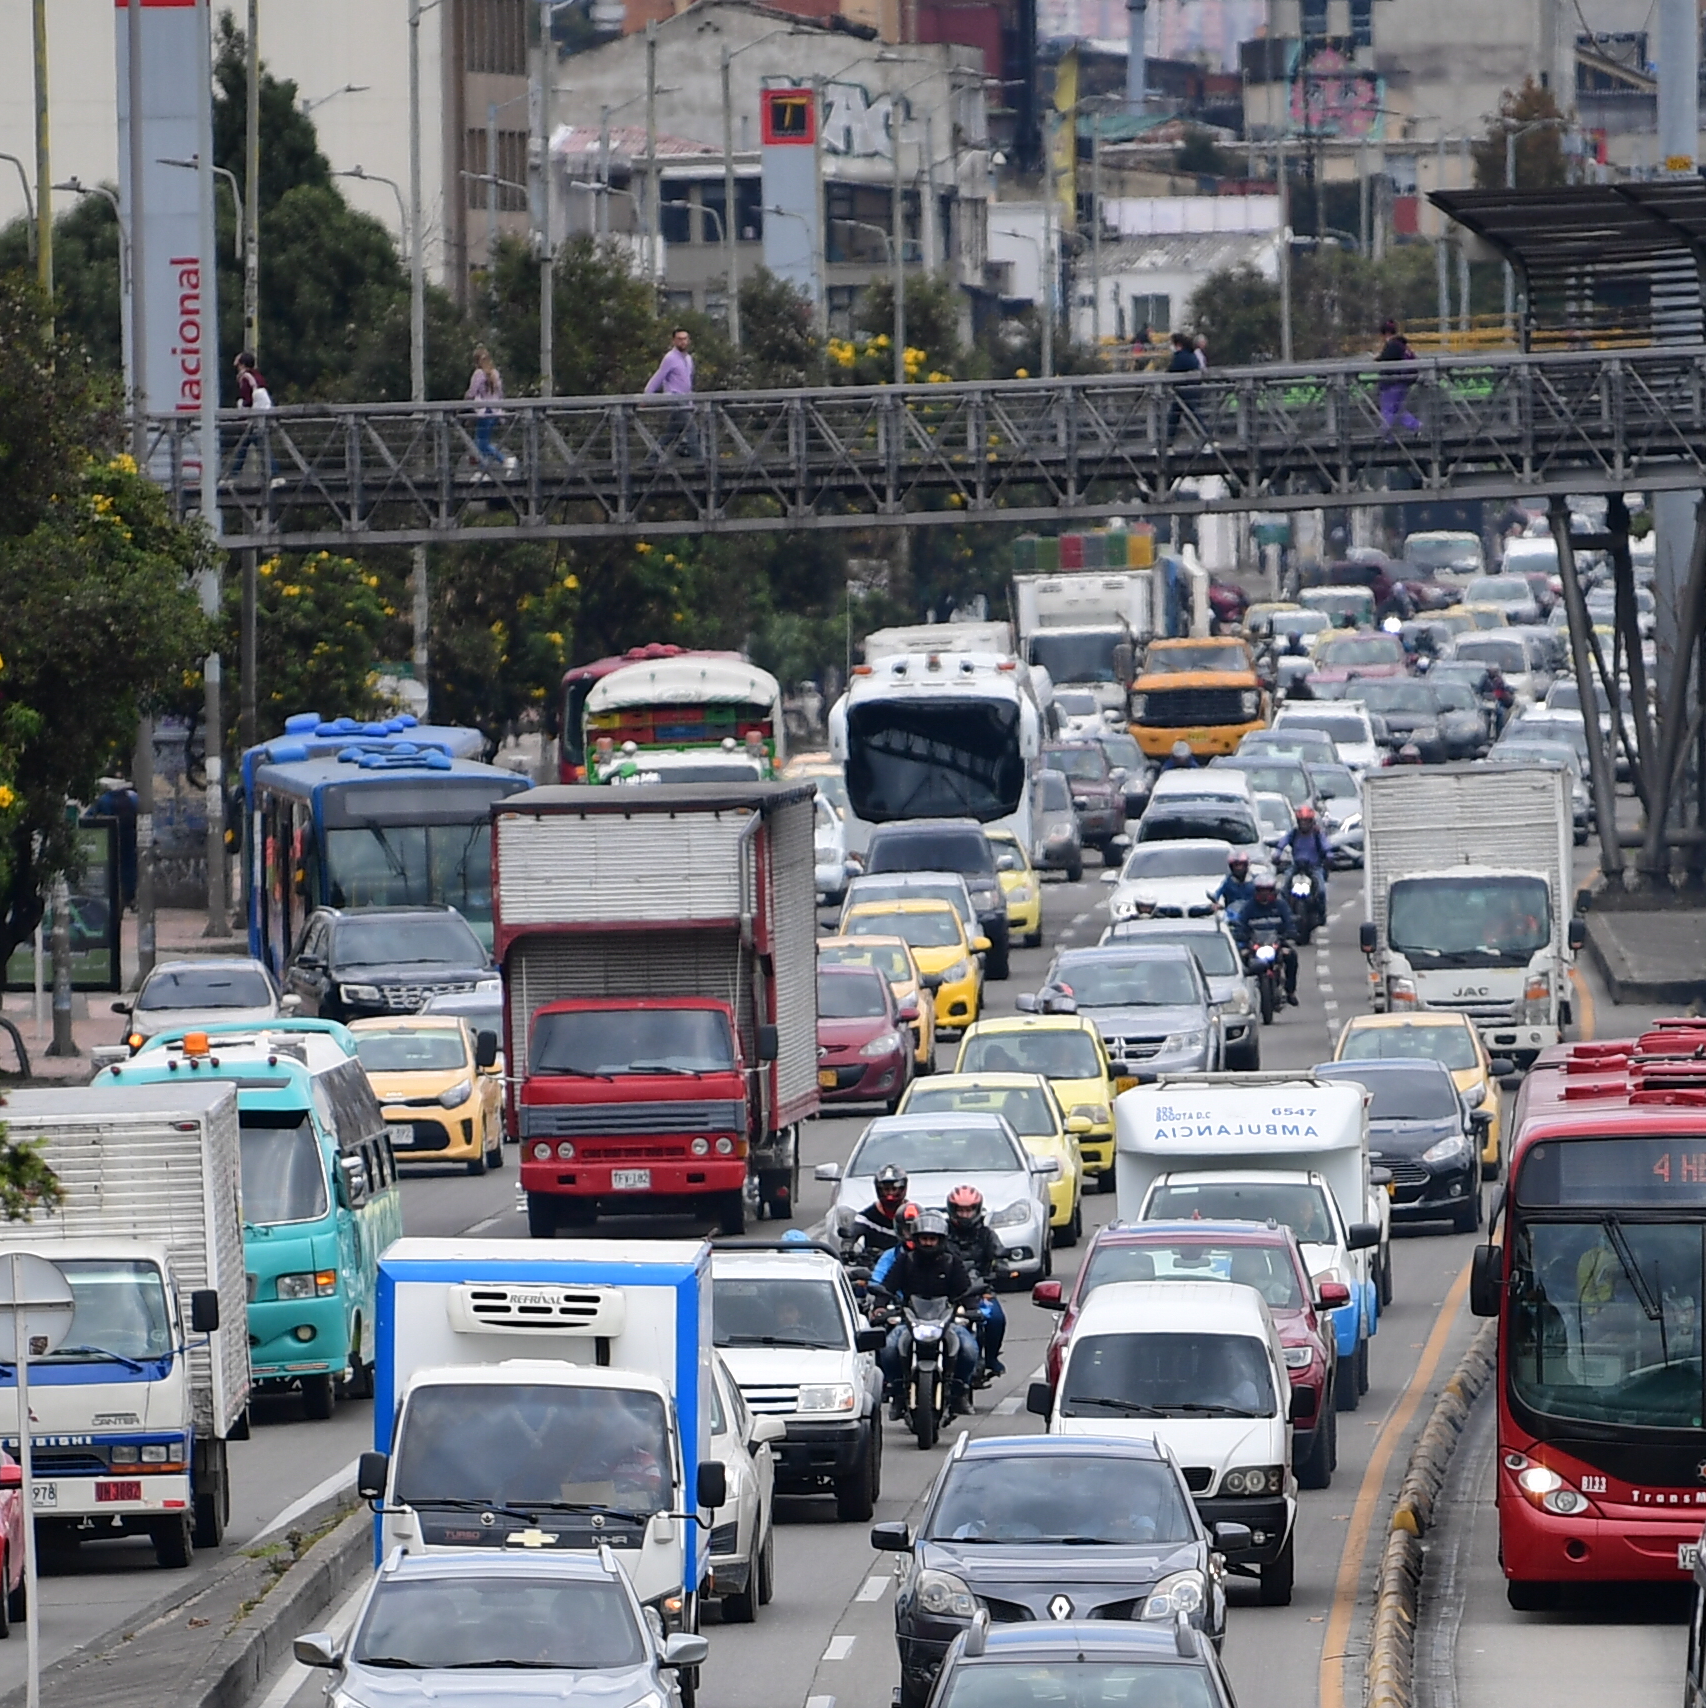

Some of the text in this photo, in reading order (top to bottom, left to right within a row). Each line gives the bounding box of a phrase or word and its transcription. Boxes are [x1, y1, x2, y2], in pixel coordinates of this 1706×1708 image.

[169, 257, 203, 412] acional
[1452, 987, 1489, 998] JAC
[1271, 1107, 1318, 1117] 6547
[1653, 1153, 1670, 1182] 4
[92, 1418, 140, 1426] CANTER
[1581, 1476, 1607, 1490] B133
[444, 1531, 480, 1540] TURBO
[591, 1535, 628, 1544] NHR
